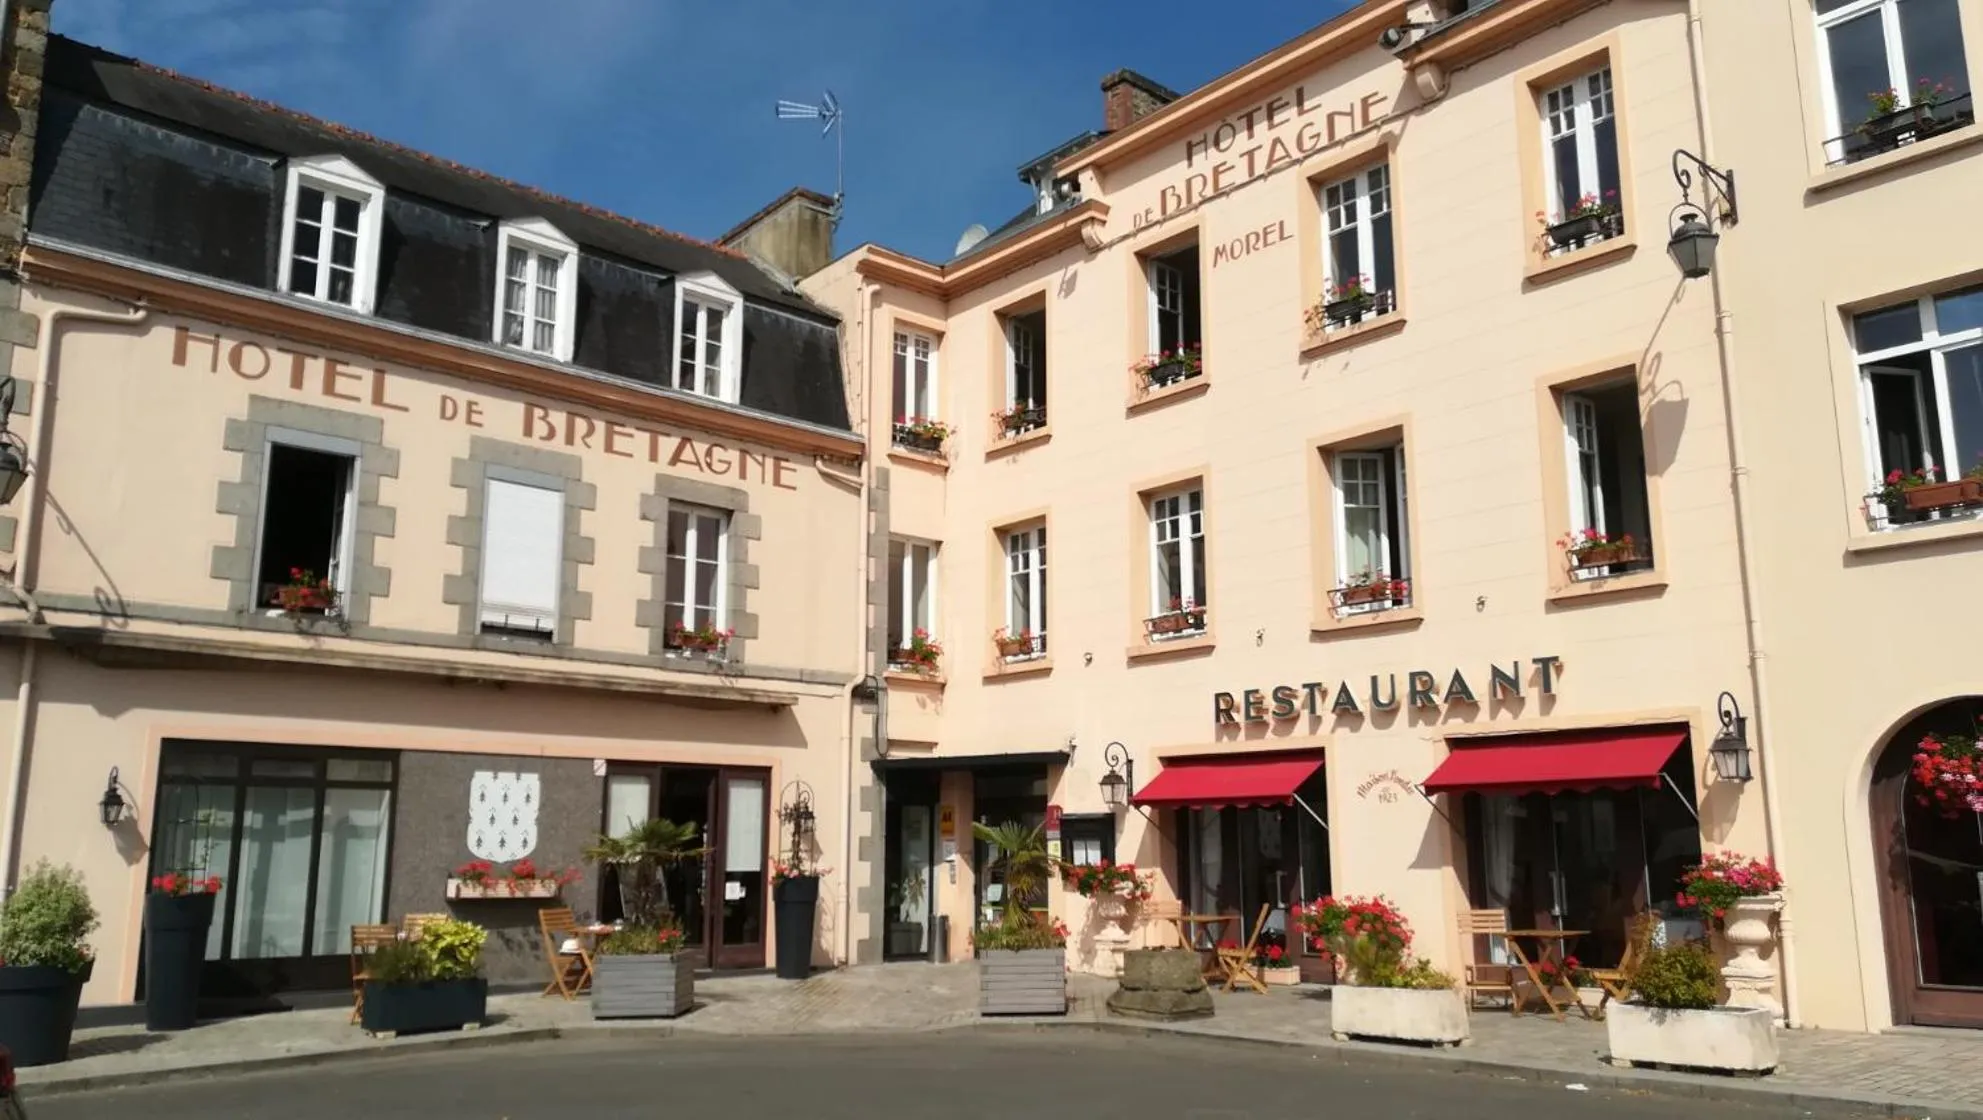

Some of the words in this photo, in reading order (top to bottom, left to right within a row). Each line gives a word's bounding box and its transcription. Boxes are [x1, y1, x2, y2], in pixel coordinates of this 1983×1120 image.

[1133, 207, 1153, 229] DE
[1160, 91, 1389, 216] BRETAGNE
[1186, 86, 1322, 169] HÔTEL
[1213, 220, 1293, 268] MOREL
[172, 327, 410, 412] HOTEL
[440, 394, 485, 428] DE
[522, 402, 798, 491] BRETAGNE
[1214, 655, 1560, 724] RESTAURANT
